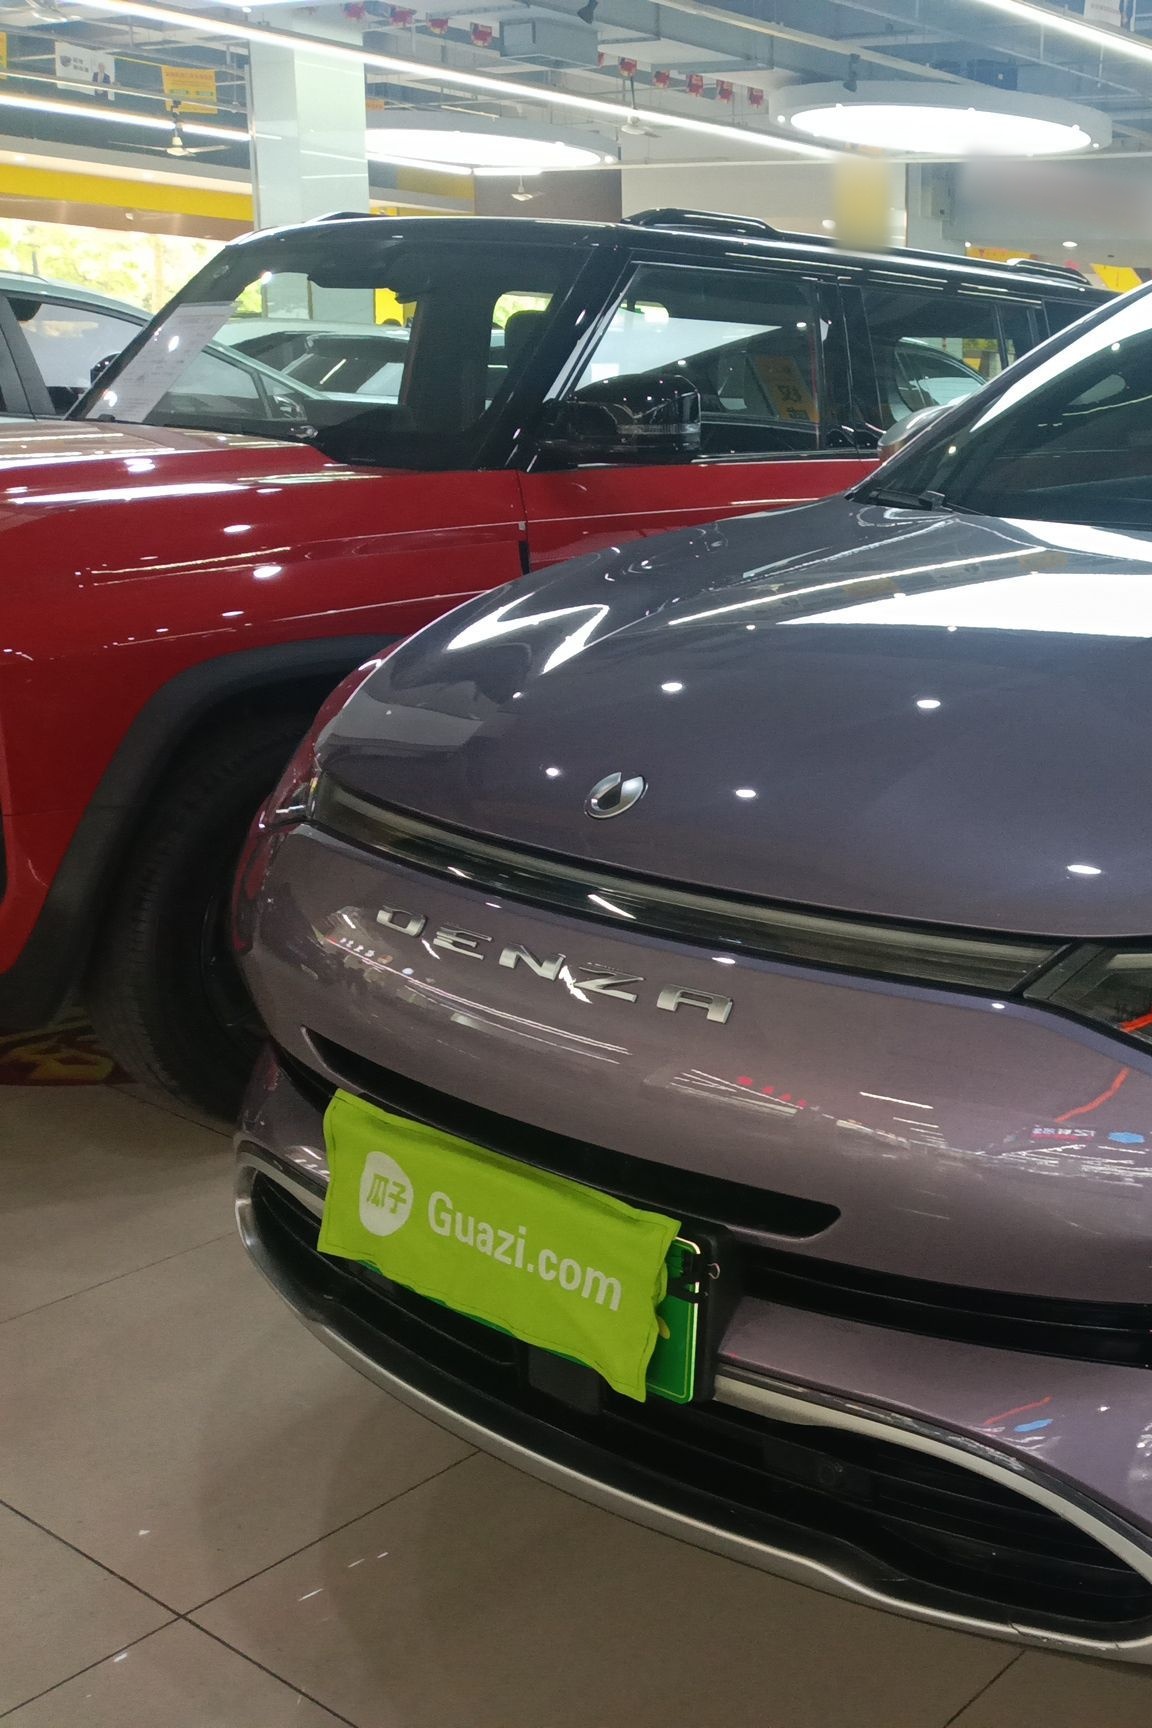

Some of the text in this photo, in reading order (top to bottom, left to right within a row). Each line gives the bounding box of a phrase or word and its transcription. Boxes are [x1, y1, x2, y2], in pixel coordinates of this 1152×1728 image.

[376, 906, 733, 1024] DENZA
[366, 1173, 408, 1214] 瓜子
[428, 1191, 622, 1311] Guazi.com
